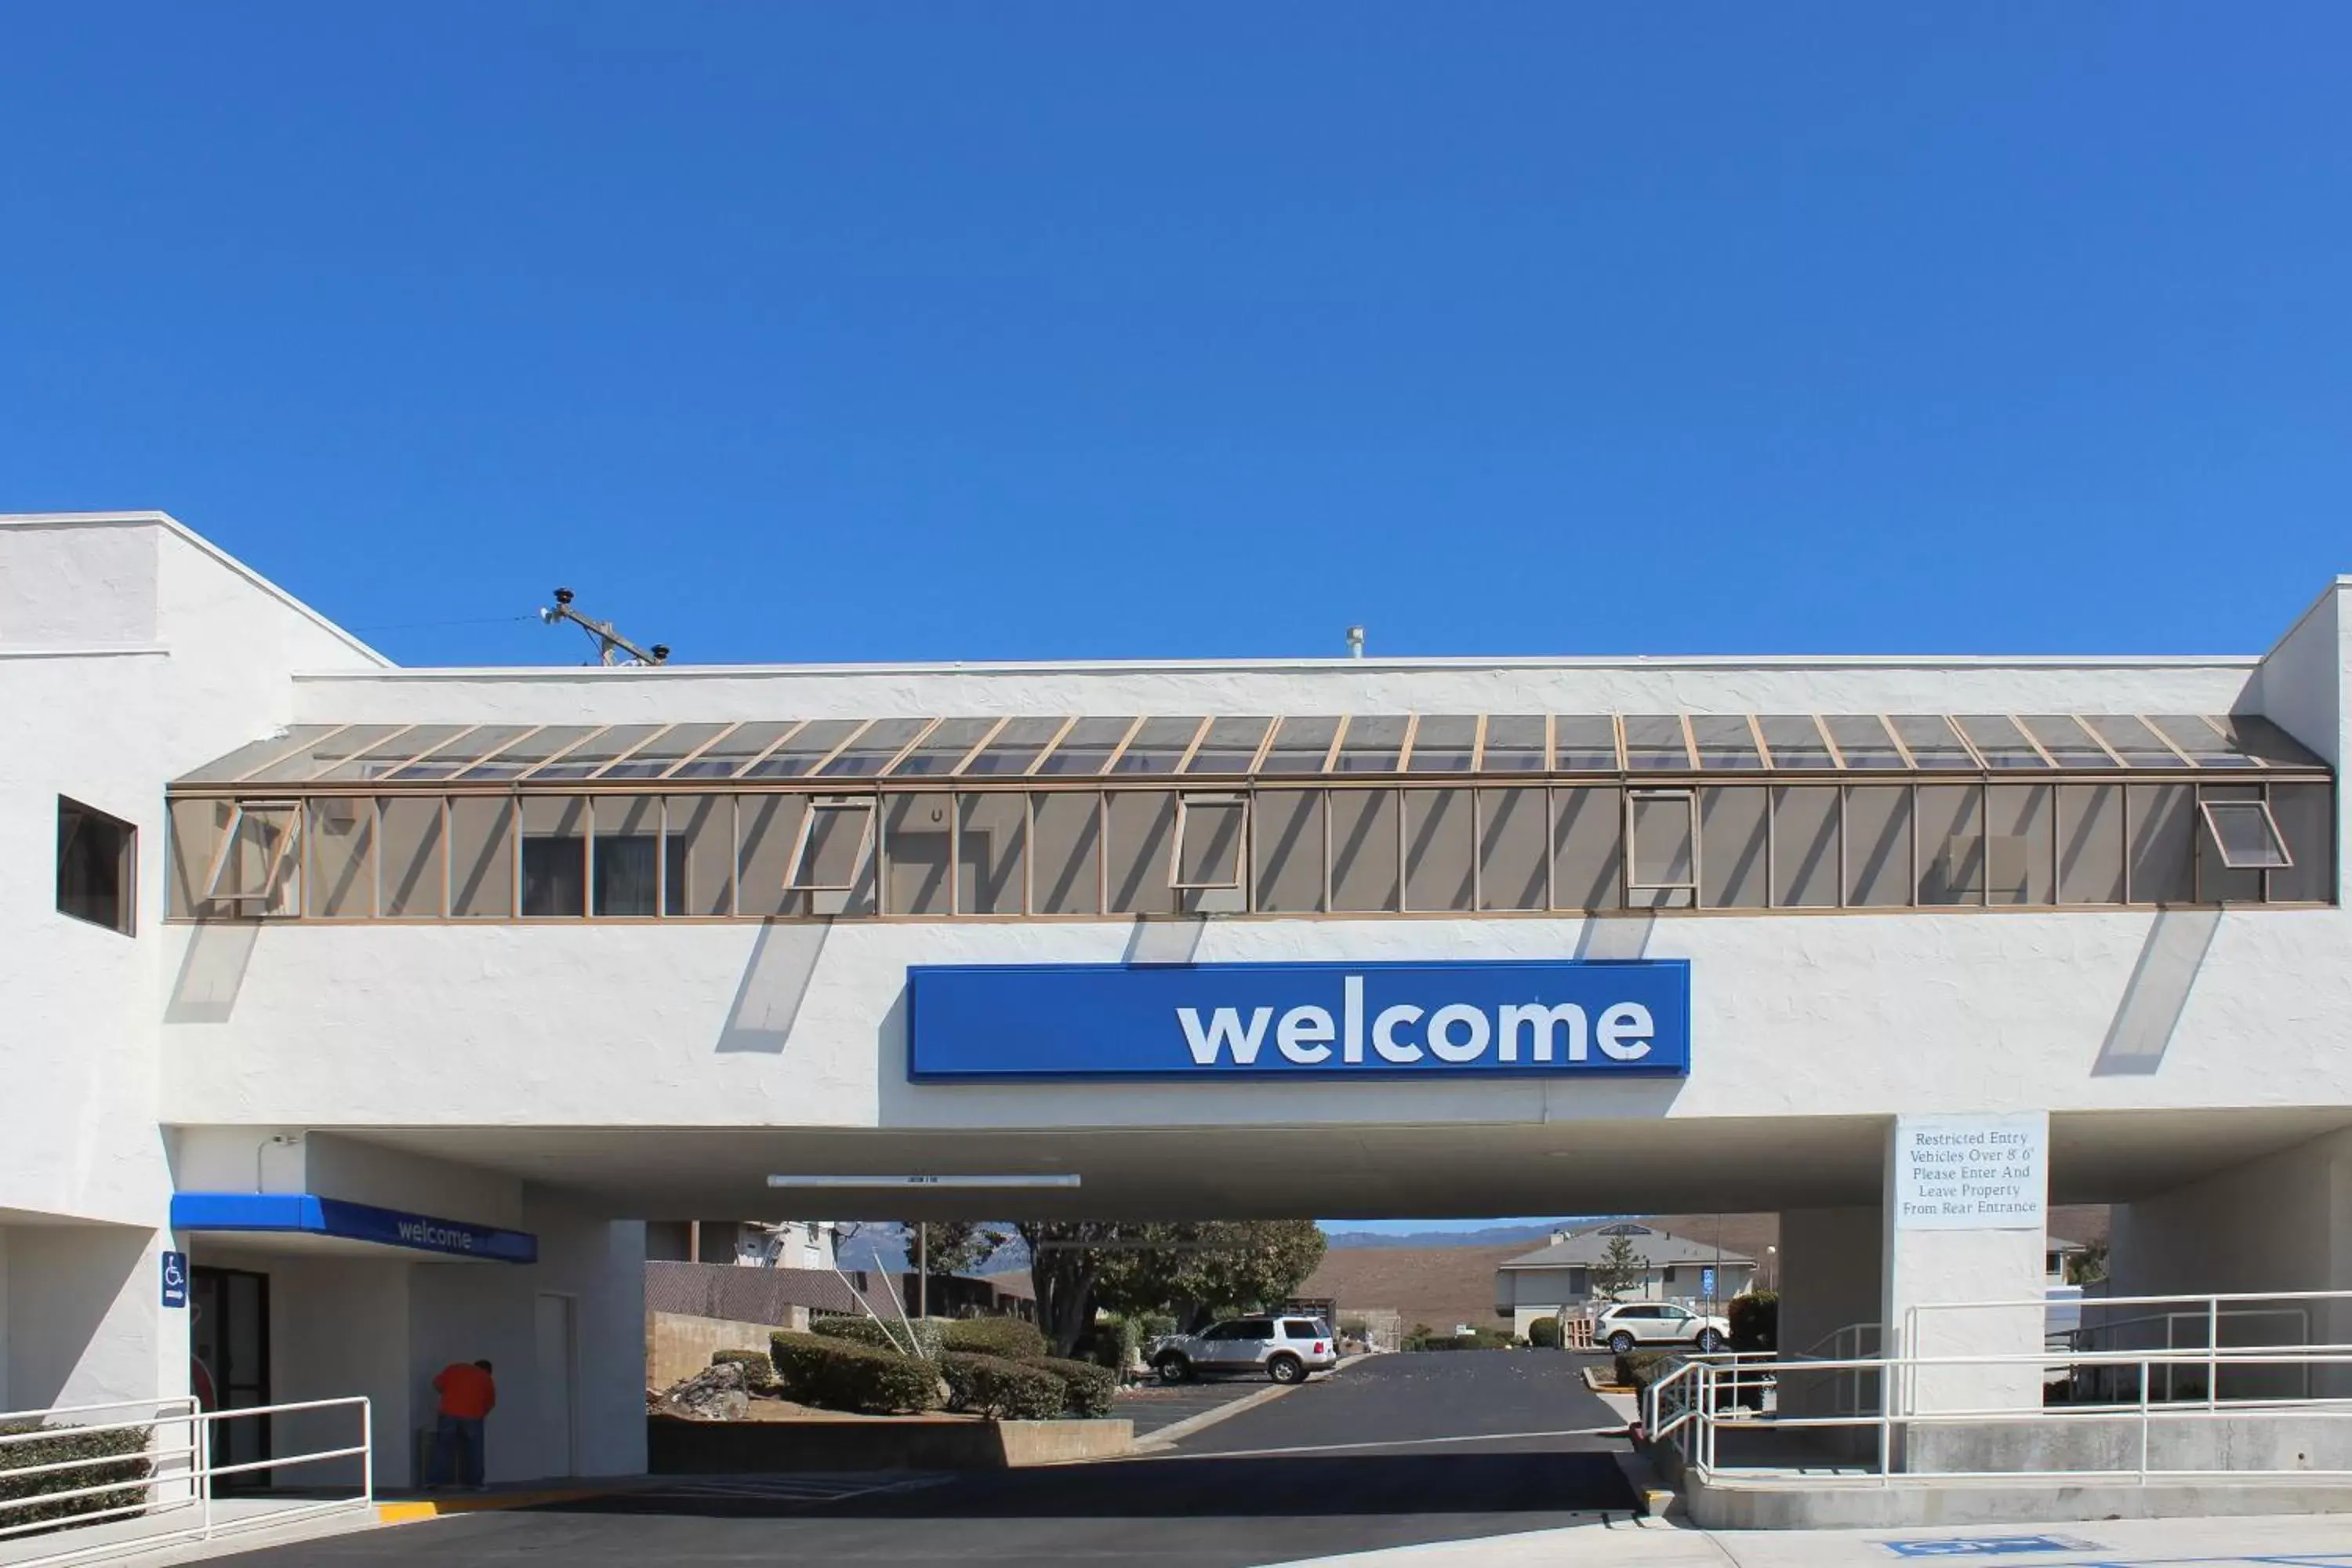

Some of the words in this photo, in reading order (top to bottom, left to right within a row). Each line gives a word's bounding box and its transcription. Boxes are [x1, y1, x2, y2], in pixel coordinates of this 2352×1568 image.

[1176, 975, 1656, 1065] welcome
[1915, 1133, 1984, 1145] Restricted
[1990, 1131, 2028, 1145] Entry
[1911, 1149, 1964, 1163] Vehicles
[1969, 1149, 2002, 1161] Over
[1913, 1167, 1956, 1180] Please
[1961, 1166, 1997, 1178] Enter
[2002, 1165, 2031, 1178] And
[1919, 1185, 1957, 1197] Leave
[1962, 1184, 2020, 1198] Property
[1904, 1202, 1936, 1214] From
[1942, 1203, 1973, 1214] Rear
[1977, 1201, 2037, 1213] Entrance
[398, 1218, 472, 1250] welcome
